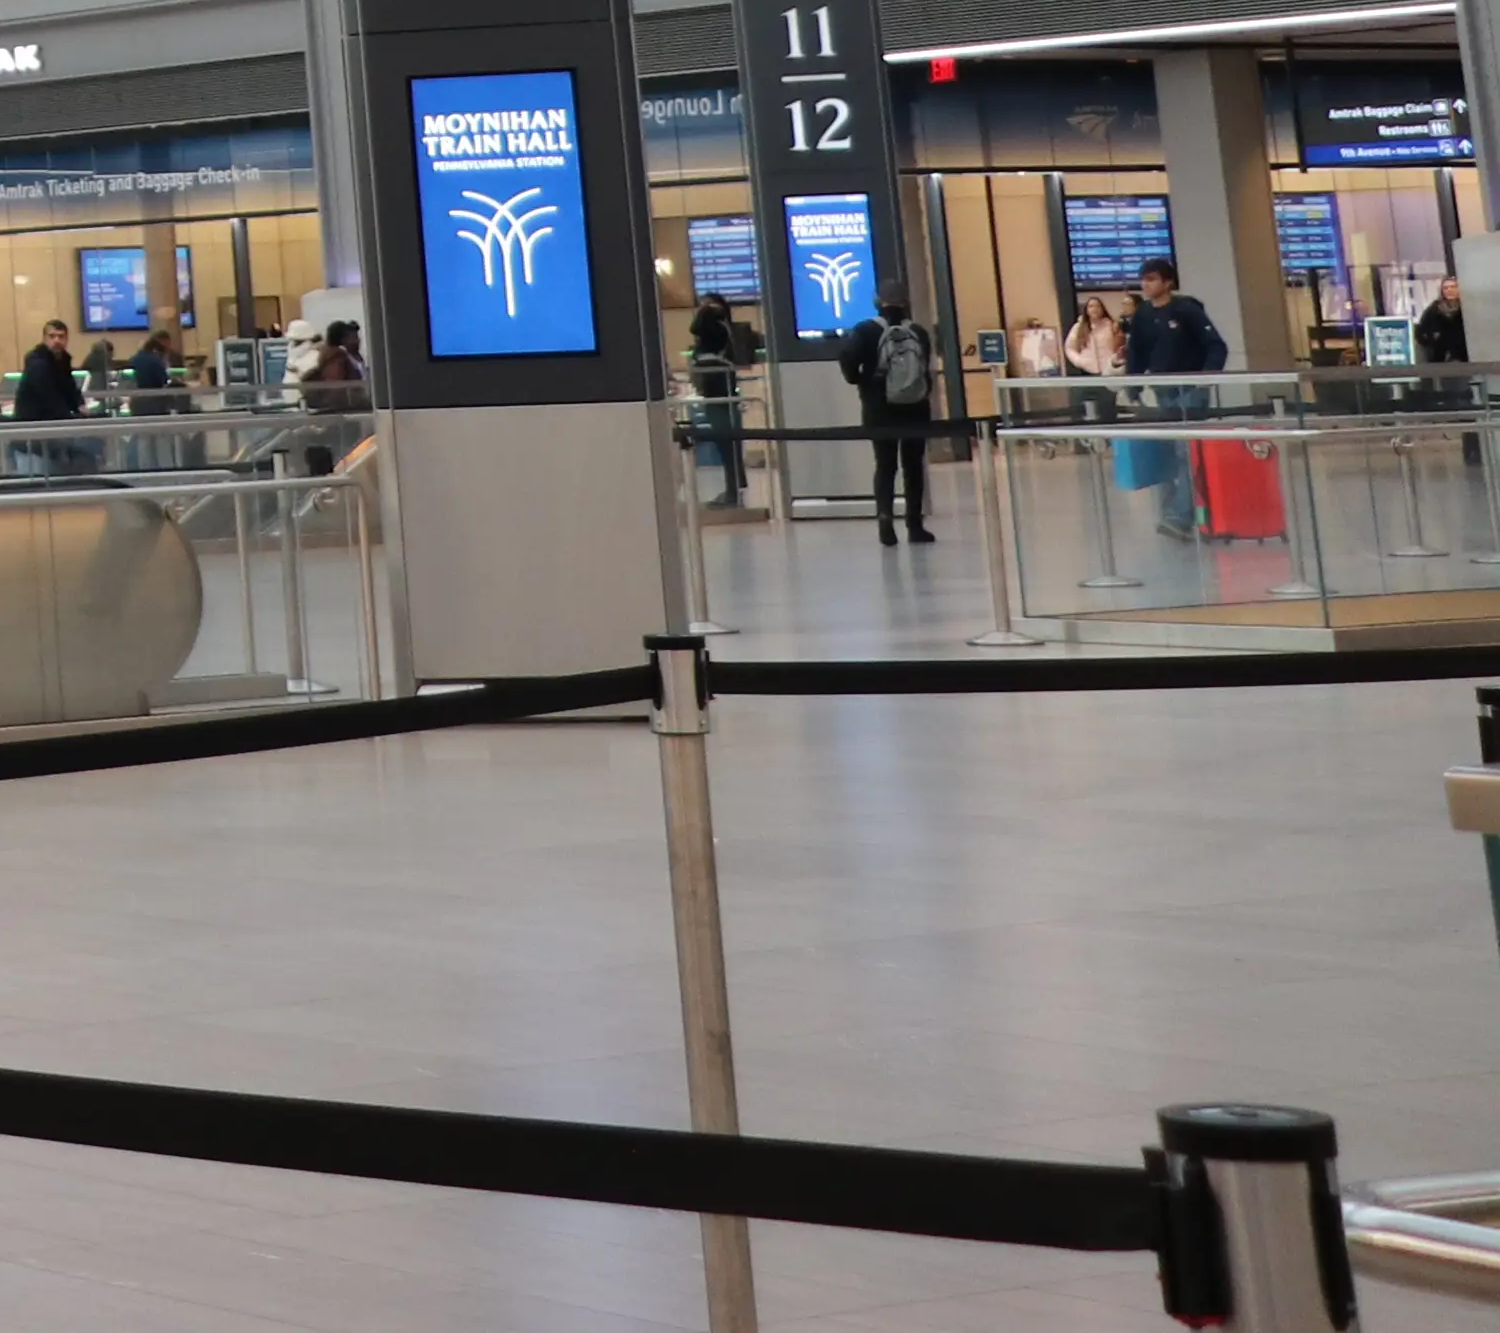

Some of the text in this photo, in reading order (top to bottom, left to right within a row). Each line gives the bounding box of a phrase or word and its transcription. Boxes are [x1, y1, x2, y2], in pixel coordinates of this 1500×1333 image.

[780, 6, 837, 59] 11
[1329, 102, 1433, 119] Amtrak Baggage Claim
[423, 109, 566, 134] MOYNIHAN
[785, 97, 851, 151] 12
[1378, 124, 1429, 136] Restrooms
[422, 130, 572, 156] TRAIN HALL
[1357, 147, 1391, 157] Avenue
[516, 156, 564, 168] STATION
[48, 175, 105, 197] Ticketing
[108, 174, 132, 191] and
[136, 171, 194, 193] Baggage
[198, 164, 260, 185] Check-in
[790, 213, 865, 226] MOYNIHAN
[790, 223, 868, 239] TRAIN HALL
